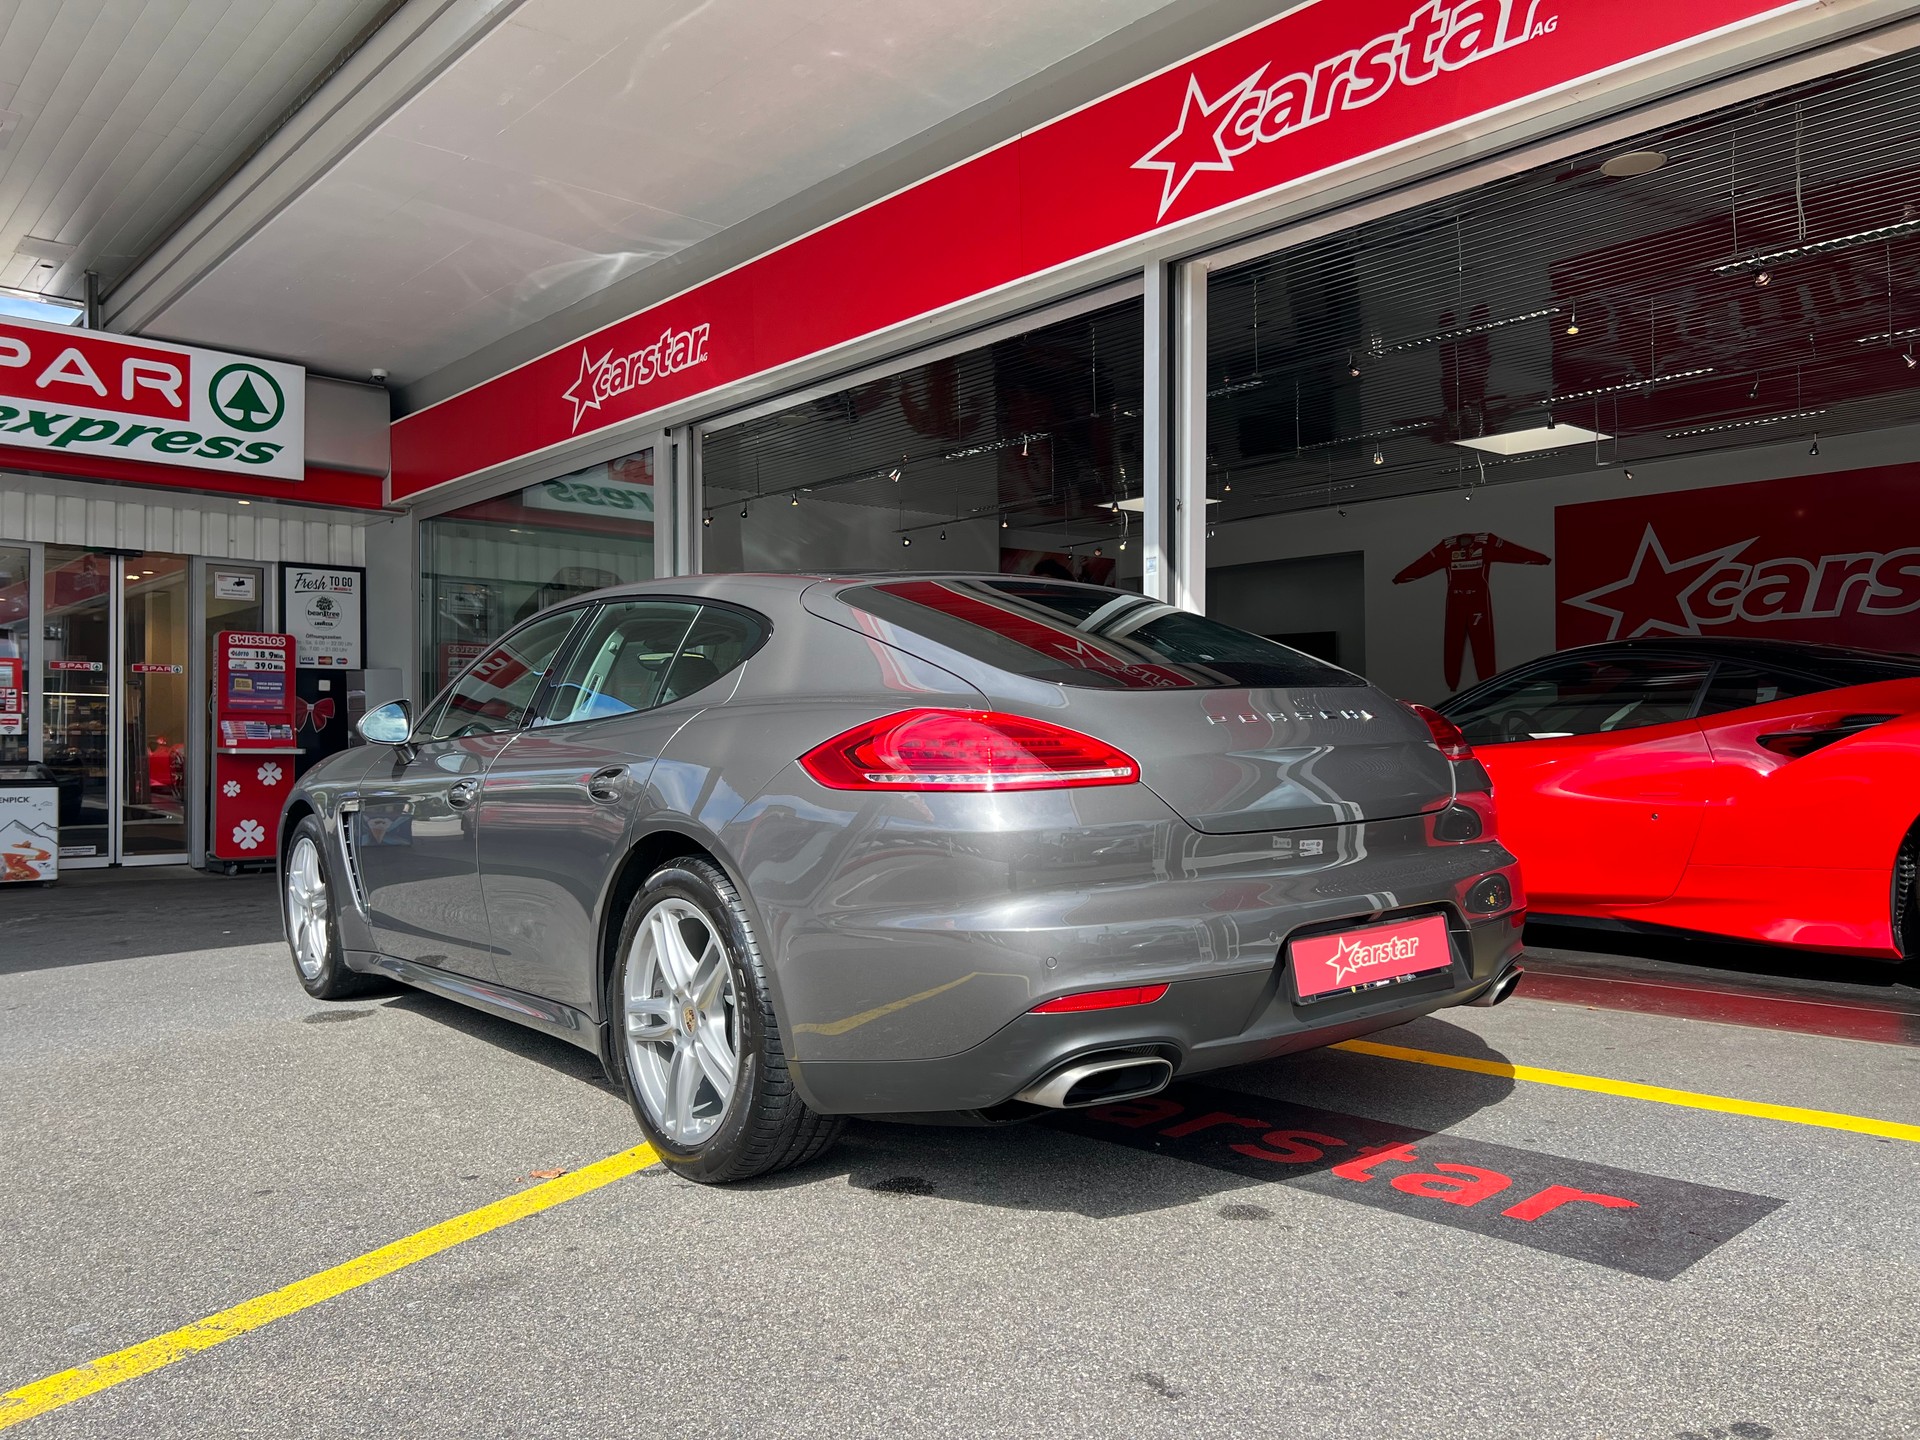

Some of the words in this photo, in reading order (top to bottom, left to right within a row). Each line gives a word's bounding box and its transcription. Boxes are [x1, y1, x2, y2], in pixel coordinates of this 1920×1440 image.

[1214, 0, 1542, 156] carstar
[1530, 15, 1557, 41] AG
[597, 323, 710, 401] carstar
[700, 352, 708, 362] AG
[294, 572, 327, 590] Fresh
[329, 575, 340, 586] TO
[342, 576, 353, 587] GO
[1473, 612, 1482, 625] 7
[229, 635, 286, 646] SWISSLOS
[254, 662, 273, 670] 39,0
[1349, 936, 1419, 968] carstar
